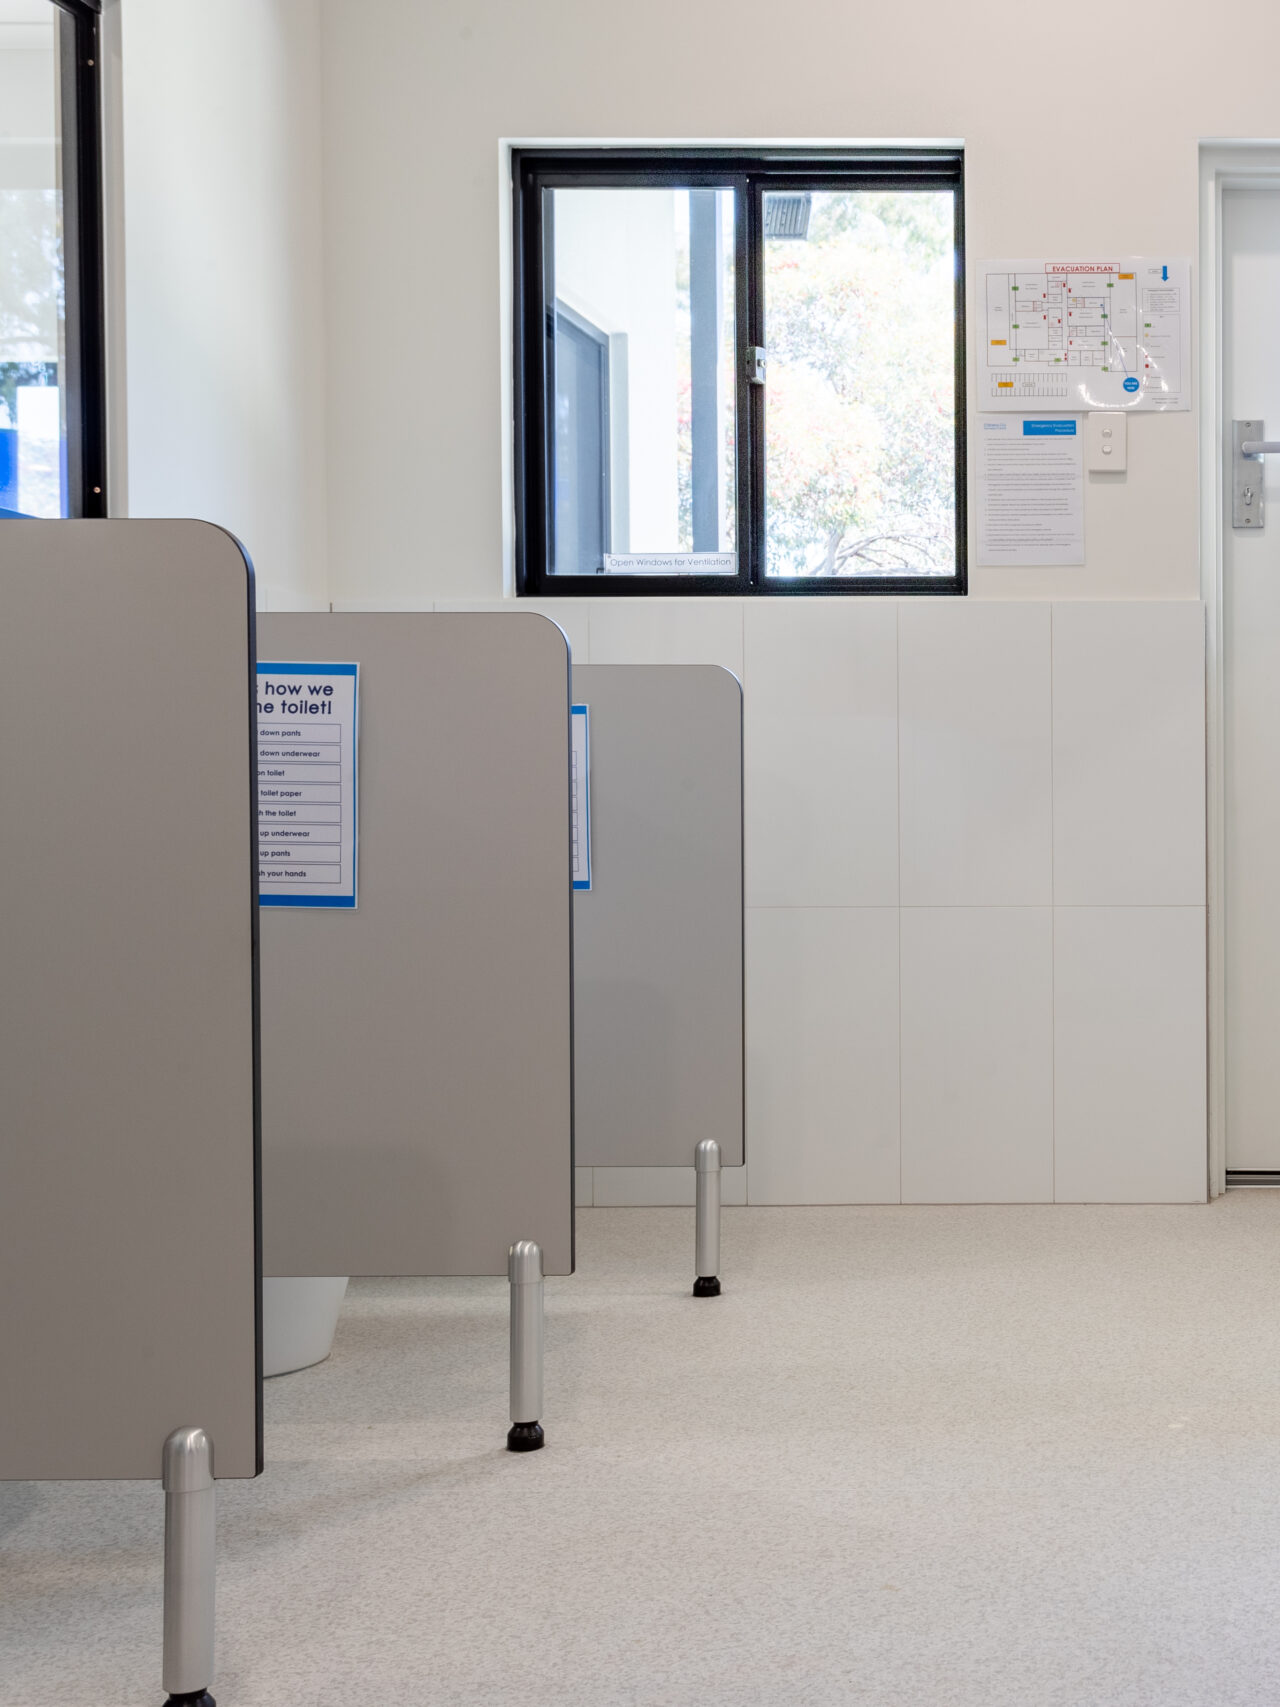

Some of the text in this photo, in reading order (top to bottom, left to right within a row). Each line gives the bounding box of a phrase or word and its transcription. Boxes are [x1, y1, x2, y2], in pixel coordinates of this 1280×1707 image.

[610, 557, 731, 567] Open Windows for Ventilation
[265, 681, 334, 696] how we
[281, 700, 332, 715] toilet!
[281, 750, 320, 758] underwear
[271, 829, 310, 837] underwear
[271, 849, 291, 857] pants
[285, 869, 307, 877] hands
